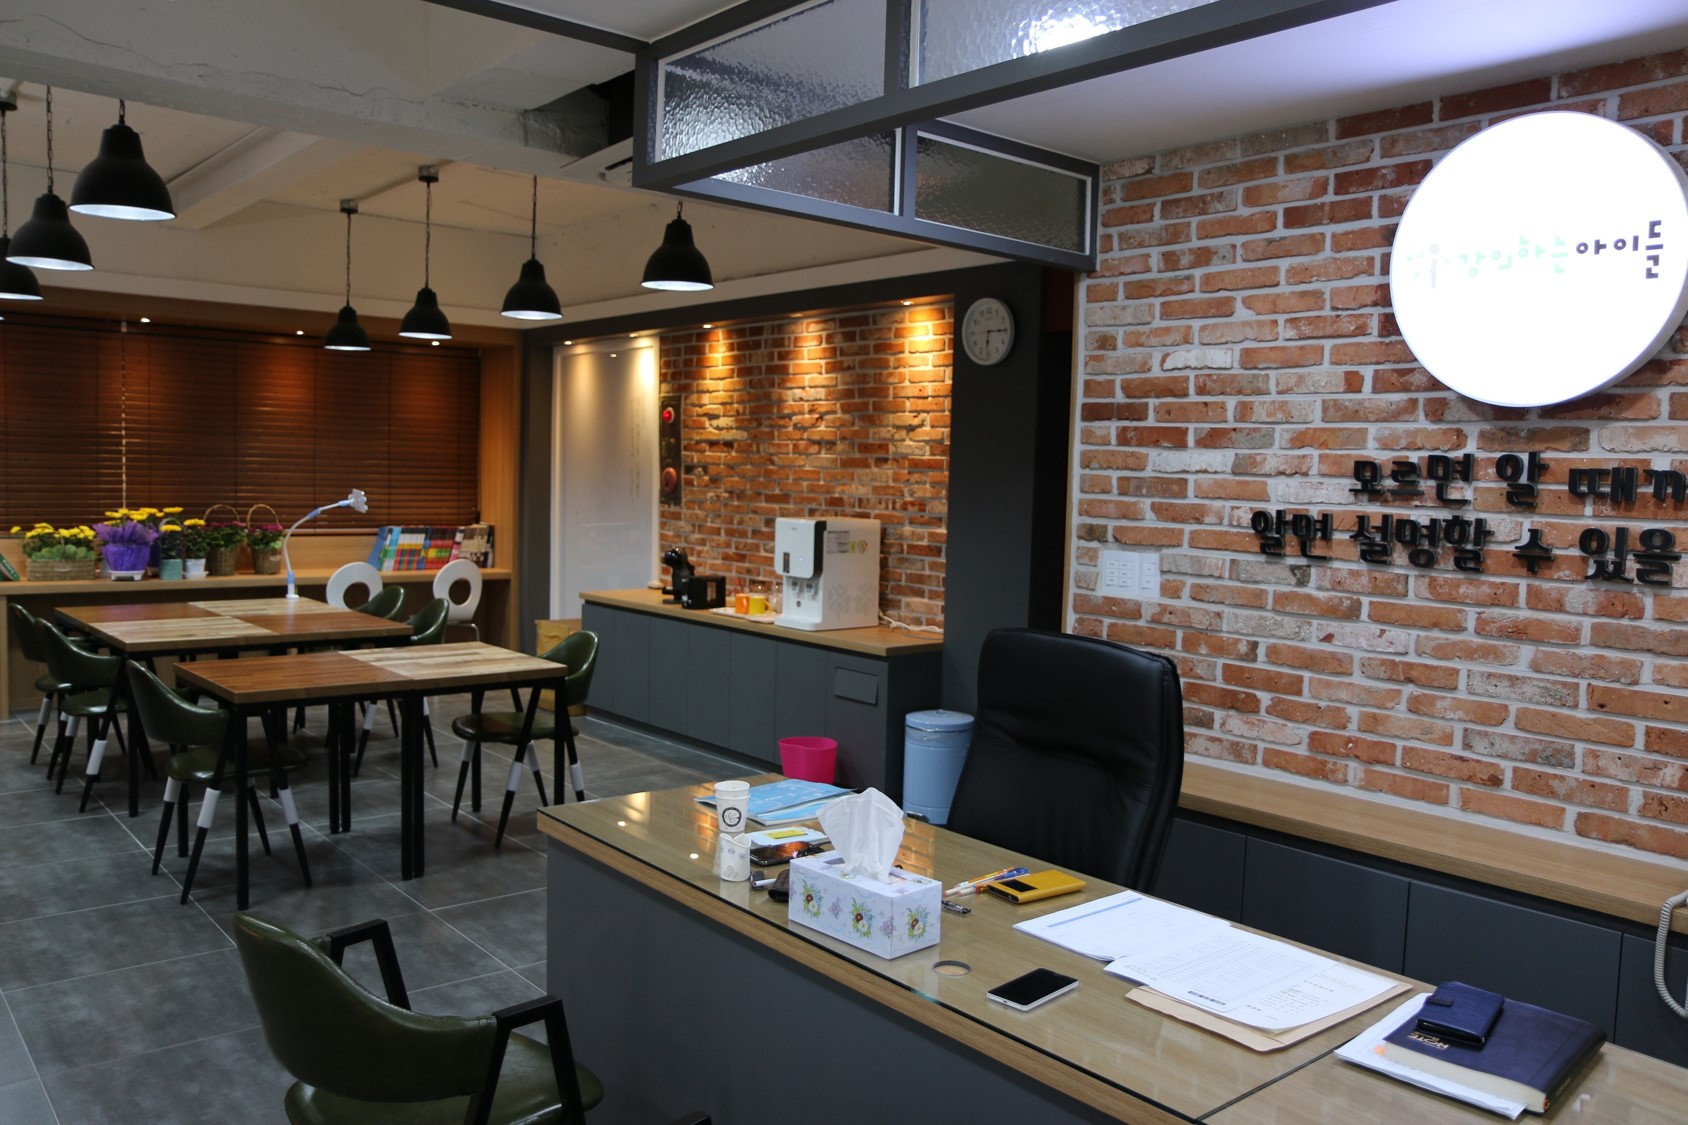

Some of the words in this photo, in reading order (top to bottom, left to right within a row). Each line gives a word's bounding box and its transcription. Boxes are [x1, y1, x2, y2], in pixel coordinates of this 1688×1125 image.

[1575, 220, 1664, 279] 아이들
[1349, 453, 1474, 504] 모르면
[1495, 452, 1549, 507] 알
[1251, 509, 1332, 559] 알면
[1350, 514, 1493, 572] 설명할
[1513, 528, 1555, 574] 수
[1579, 527, 1682, 587] 있을
